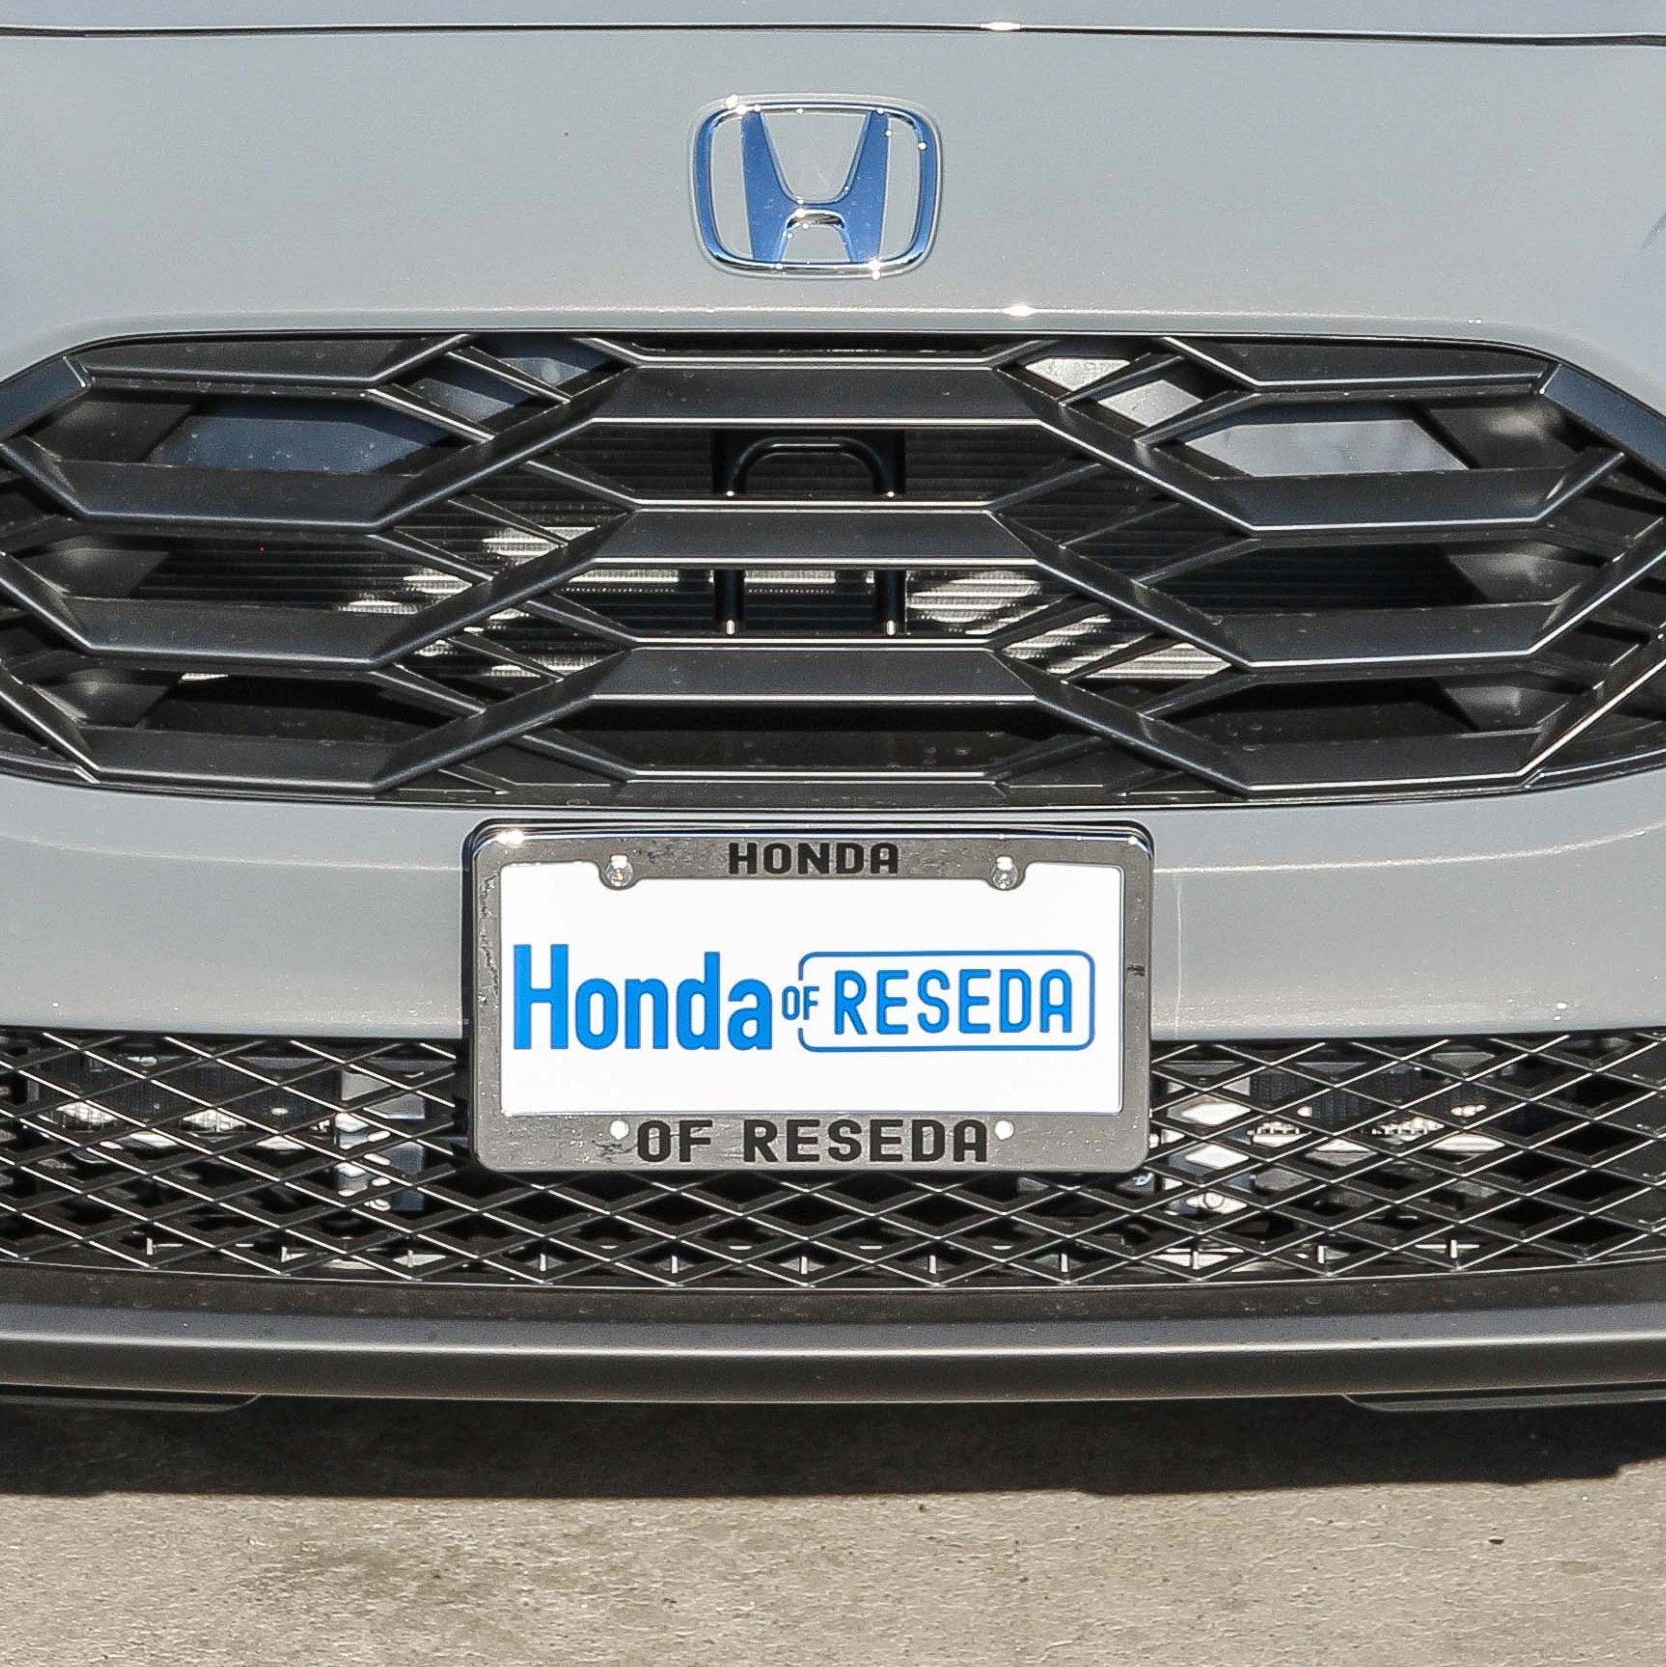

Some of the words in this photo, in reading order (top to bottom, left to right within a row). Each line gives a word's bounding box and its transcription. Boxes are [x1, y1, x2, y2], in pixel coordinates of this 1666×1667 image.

[728, 842, 899, 875] HONDA
[513, 944, 774, 1050] Honda
[781, 985, 820, 1020] OF
[833, 968, 1074, 1035] RESEDA
[637, 1119, 713, 1163] OF
[743, 1119, 988, 1163] RESEDA
